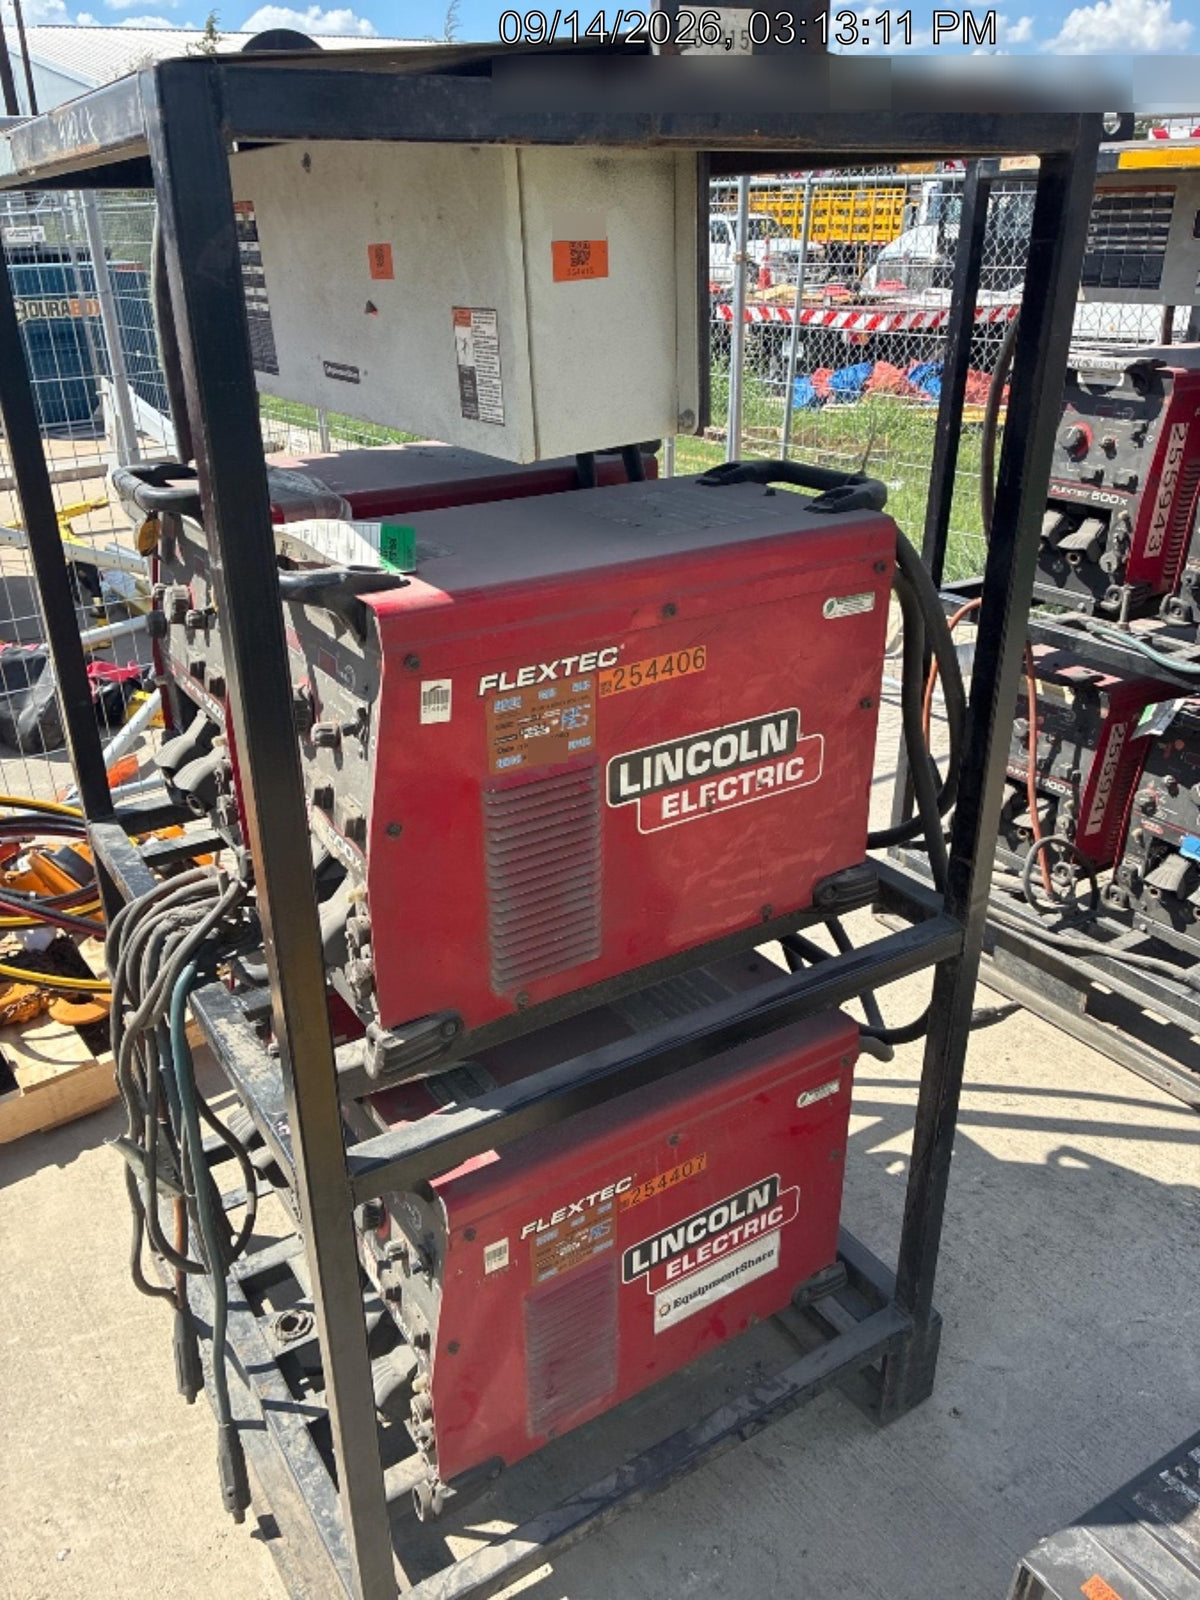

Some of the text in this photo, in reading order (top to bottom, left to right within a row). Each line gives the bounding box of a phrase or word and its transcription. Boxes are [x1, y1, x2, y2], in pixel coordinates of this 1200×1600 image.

[1149, 422, 1189, 552] 255943
[477, 646, 620, 698] FLEXTEC
[612, 646, 706, 691] 254406
[619, 719, 790, 798] LINCOLN
[661, 756, 805, 820] ELECTRIC
[520, 1176, 633, 1240] FLEXTEC
[632, 1153, 706, 1205] 254407
[631, 1182, 771, 1275] LINCOLN
[666, 1205, 784, 1281] ELECTRIC
[672, 1248, 775, 1310] EquipmentShare
